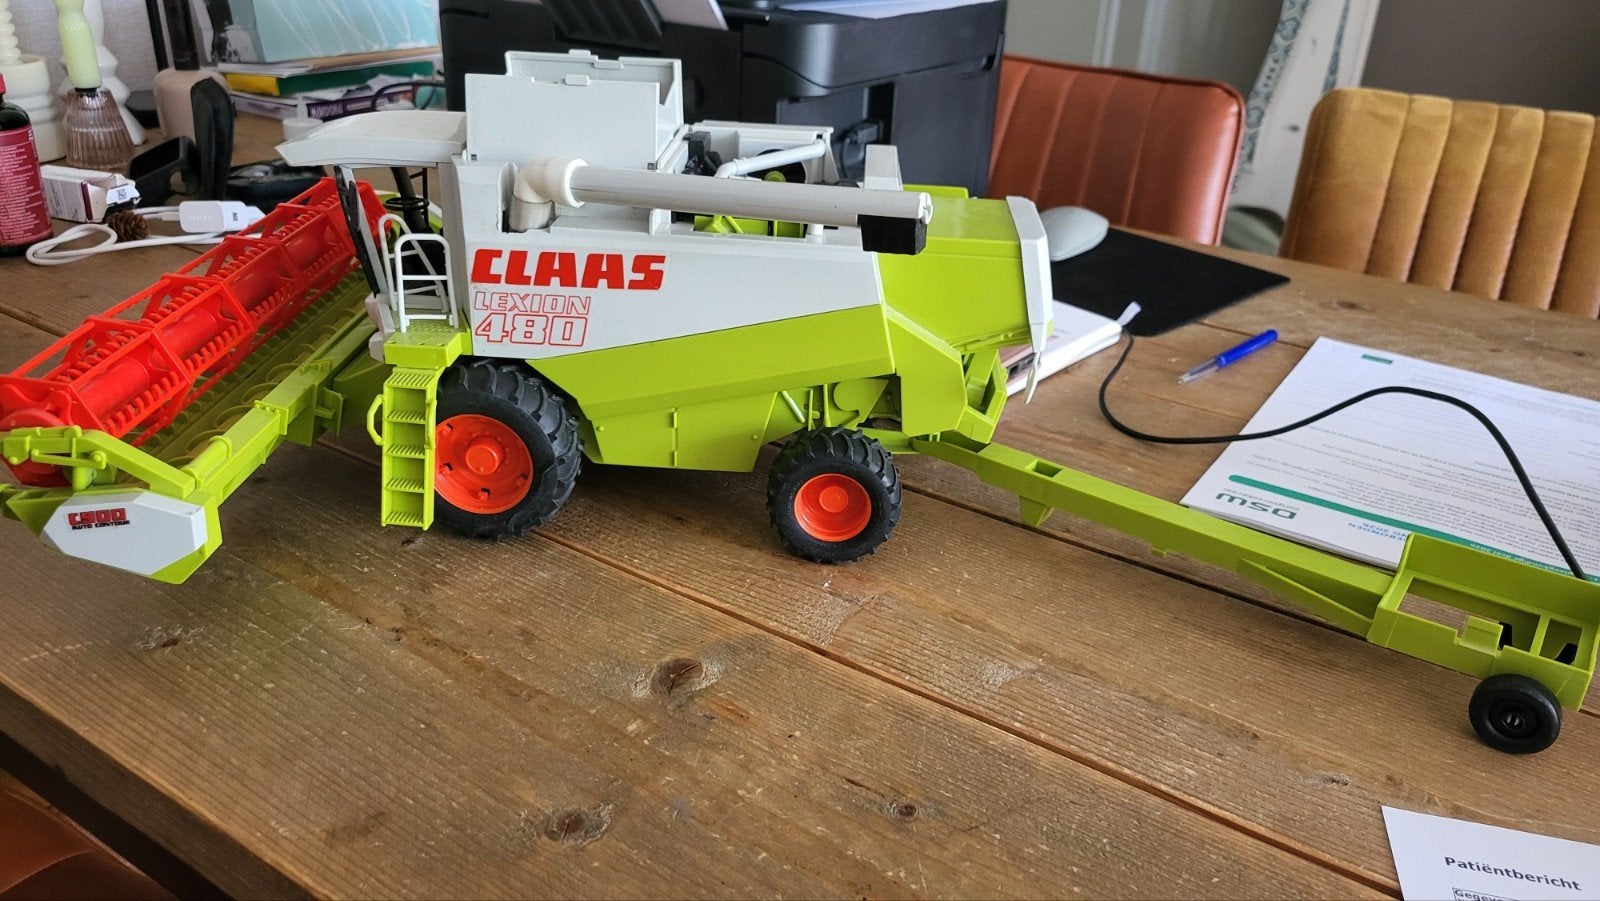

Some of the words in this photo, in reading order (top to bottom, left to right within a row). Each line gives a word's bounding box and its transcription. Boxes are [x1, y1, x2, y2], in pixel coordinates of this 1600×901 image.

[471, 249, 667, 290] CLAAS
[474, 291, 592, 316] LEXION
[474, 312, 588, 347] 480
[1215, 492, 1297, 520] DSW
[1348, 522, 1406, 540] EBONDEN
[1444, 856, 1582, 891] Patiëntbericht
